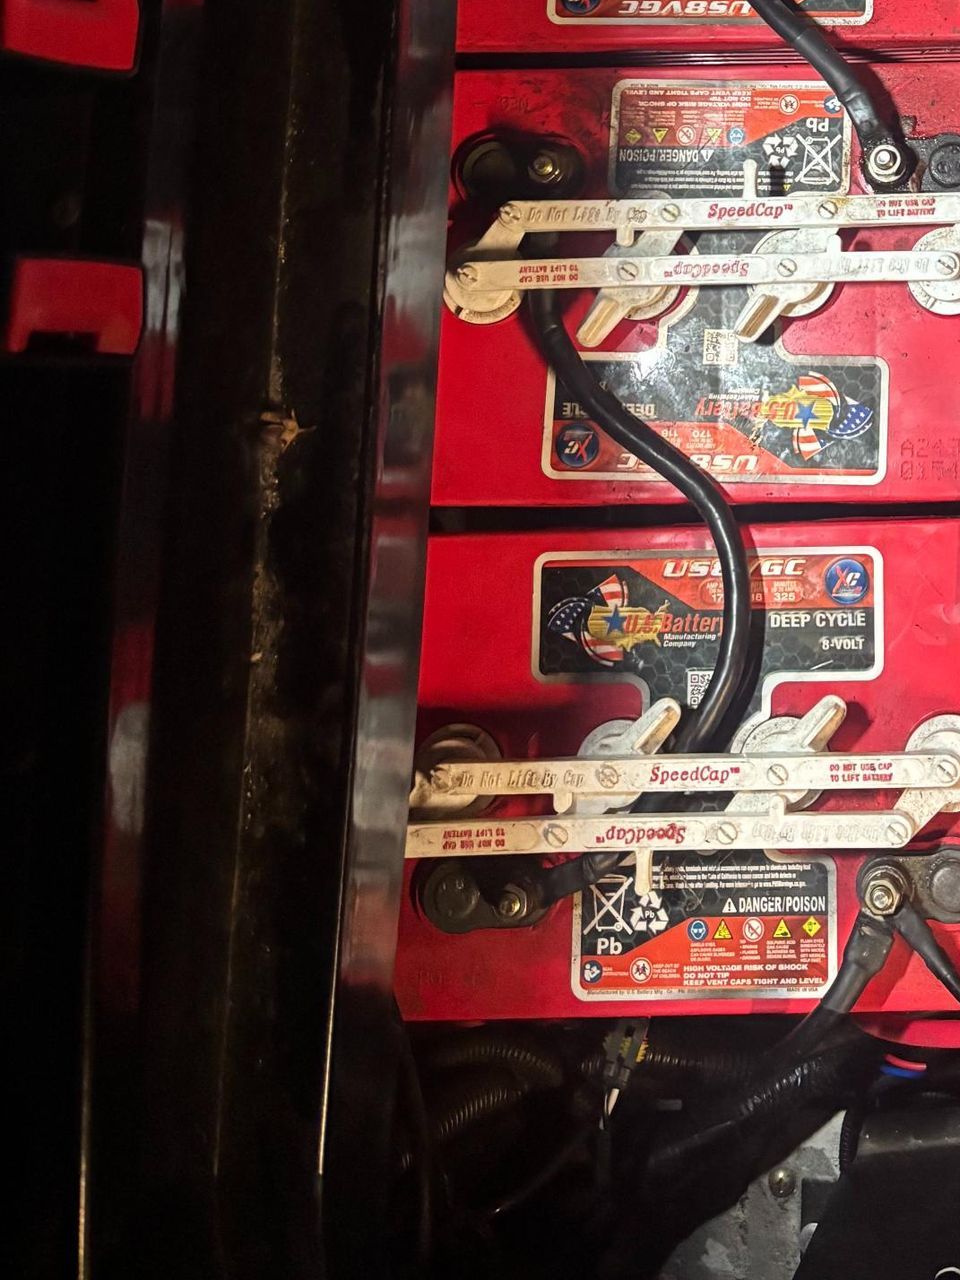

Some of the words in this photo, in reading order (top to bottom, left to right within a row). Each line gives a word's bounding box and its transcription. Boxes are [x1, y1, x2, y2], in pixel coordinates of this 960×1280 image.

[617, 0, 752, 16] US8VGC
[805, 117, 829, 131] Pb
[775, 146, 785, 154] Pb
[519, 266, 547, 274] BATTERY
[569, 265, 578, 273] TO
[622, 402, 655, 415] DEE
[694, 400, 763, 419] Battery
[691, 429, 711, 437] 170
[616, 453, 758, 471] US8C
[663, 559, 806, 578] USGC
[773, 592, 796, 602] 325
[770, 613, 811, 628] DEEP
[814, 613, 867, 628] CYCLE
[663, 633, 718, 642] Manufacturing
[663, 641, 698, 649] Company
[829, 764, 840, 772] DO
[878, 763, 892, 771] CAP
[842, 773, 859, 782] LIFT
[738, 896, 826, 913] DANGER/POISON
[644, 909, 655, 918] Pb
[596, 938, 623, 955] Pb
[683, 964, 703, 972] HIGH
[744, 963, 763, 971] RISK
[765, 963, 777, 971] OF
[778, 963, 809, 971] SHOCK
[683, 978, 704, 986] KEEP
[706, 978, 728, 986] VENT
[730, 978, 752, 986] CAPS
[799, 977, 825, 985] LEVEL
